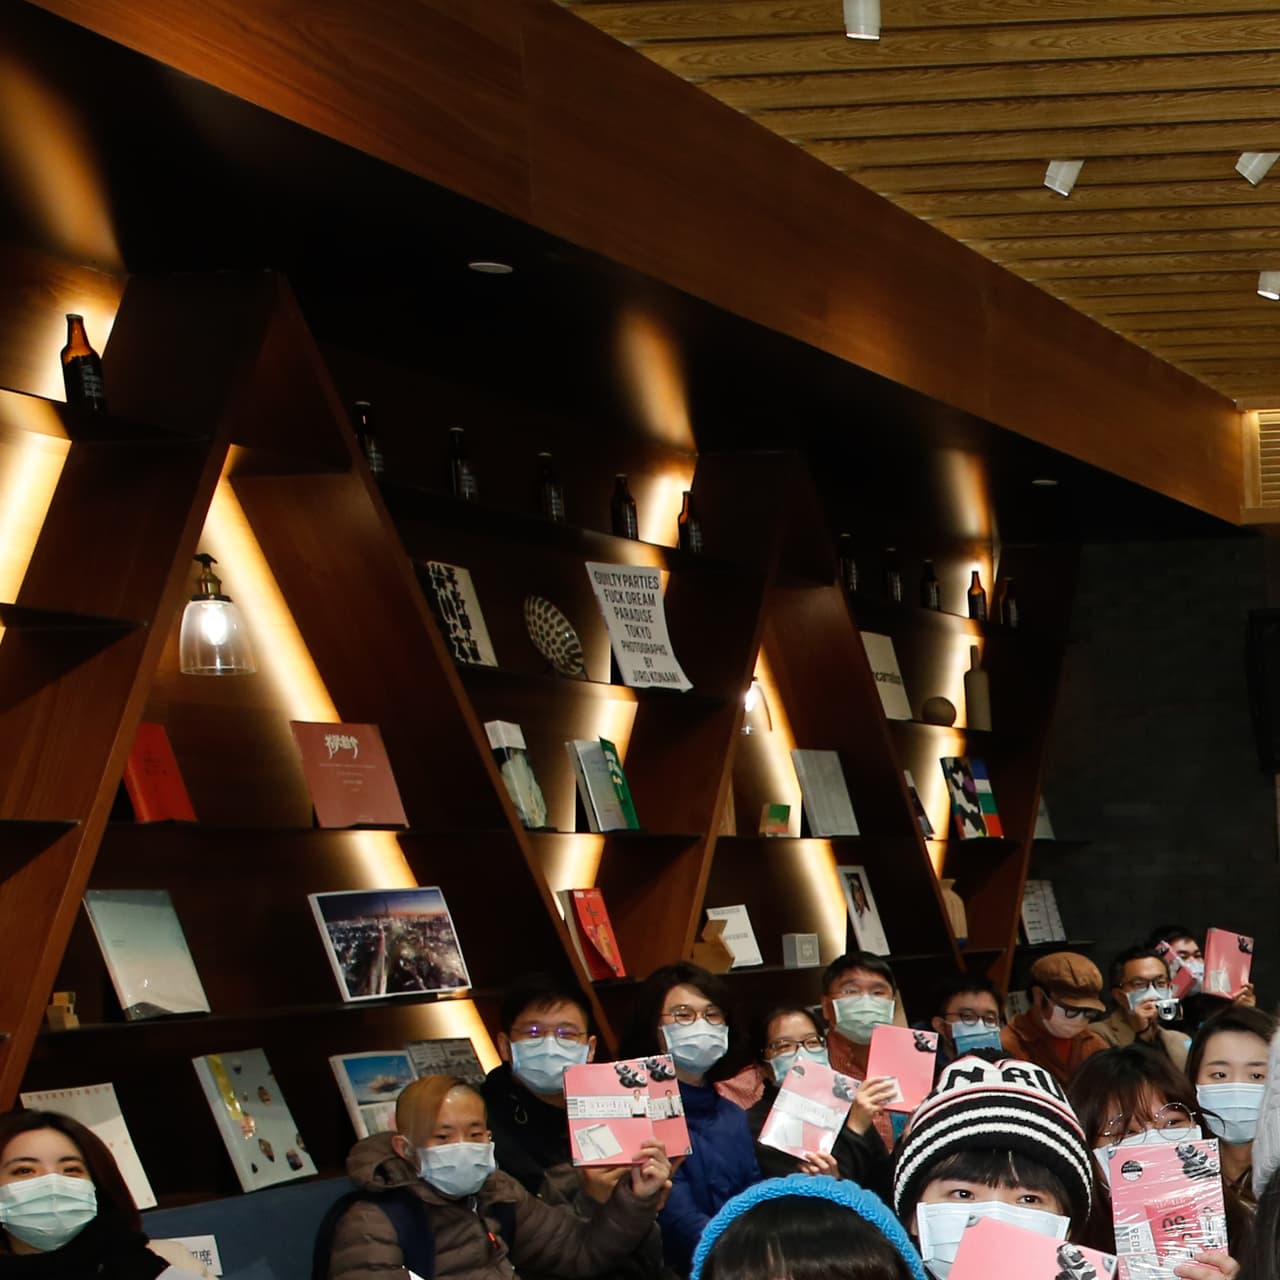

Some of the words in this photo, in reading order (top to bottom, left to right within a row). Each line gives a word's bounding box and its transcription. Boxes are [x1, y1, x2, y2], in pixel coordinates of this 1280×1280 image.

[622, 574, 660, 590] PARTIES
[603, 589, 624, 603] FUCK
[624, 591, 657, 607] DREAM
[613, 606, 655, 624] PARADISE
[624, 624, 652, 640] TOKYO
